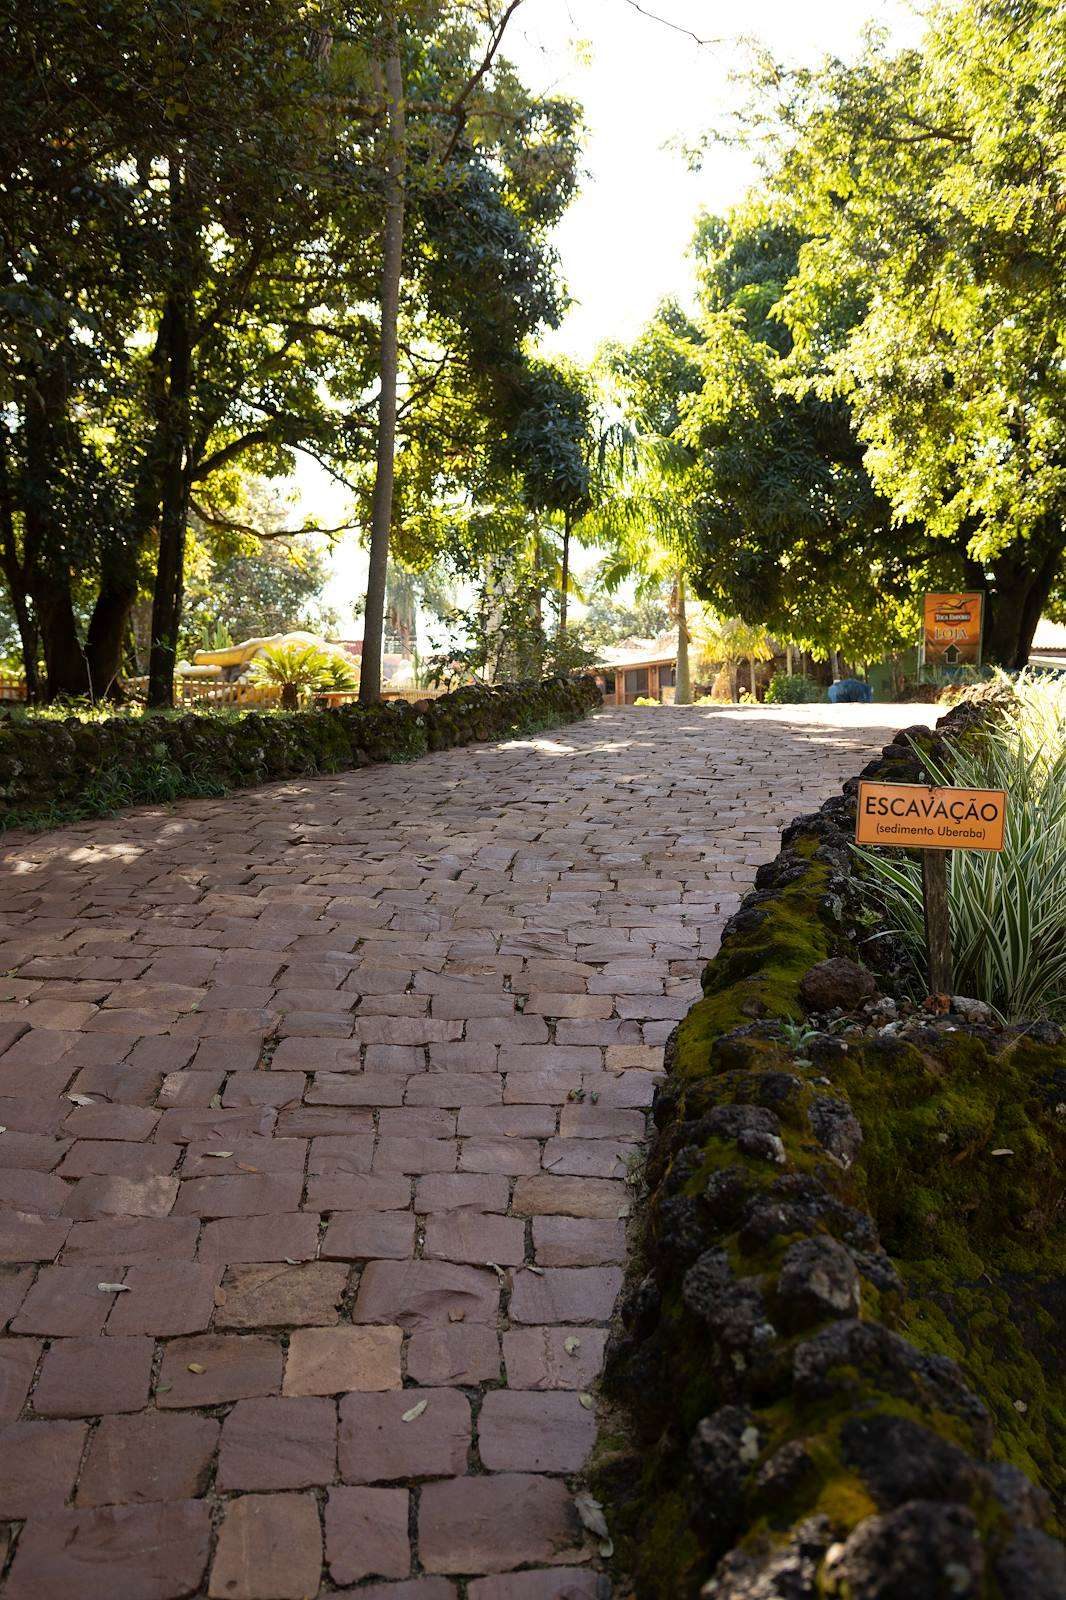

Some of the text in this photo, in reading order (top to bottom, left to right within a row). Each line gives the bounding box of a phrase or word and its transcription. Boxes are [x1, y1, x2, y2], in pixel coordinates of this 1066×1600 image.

[934, 626, 969, 640] LOJA
[865, 796, 998, 825] ESCAVAÇÃO
[876, 823, 986, 840] (sedimento Uberaba)
